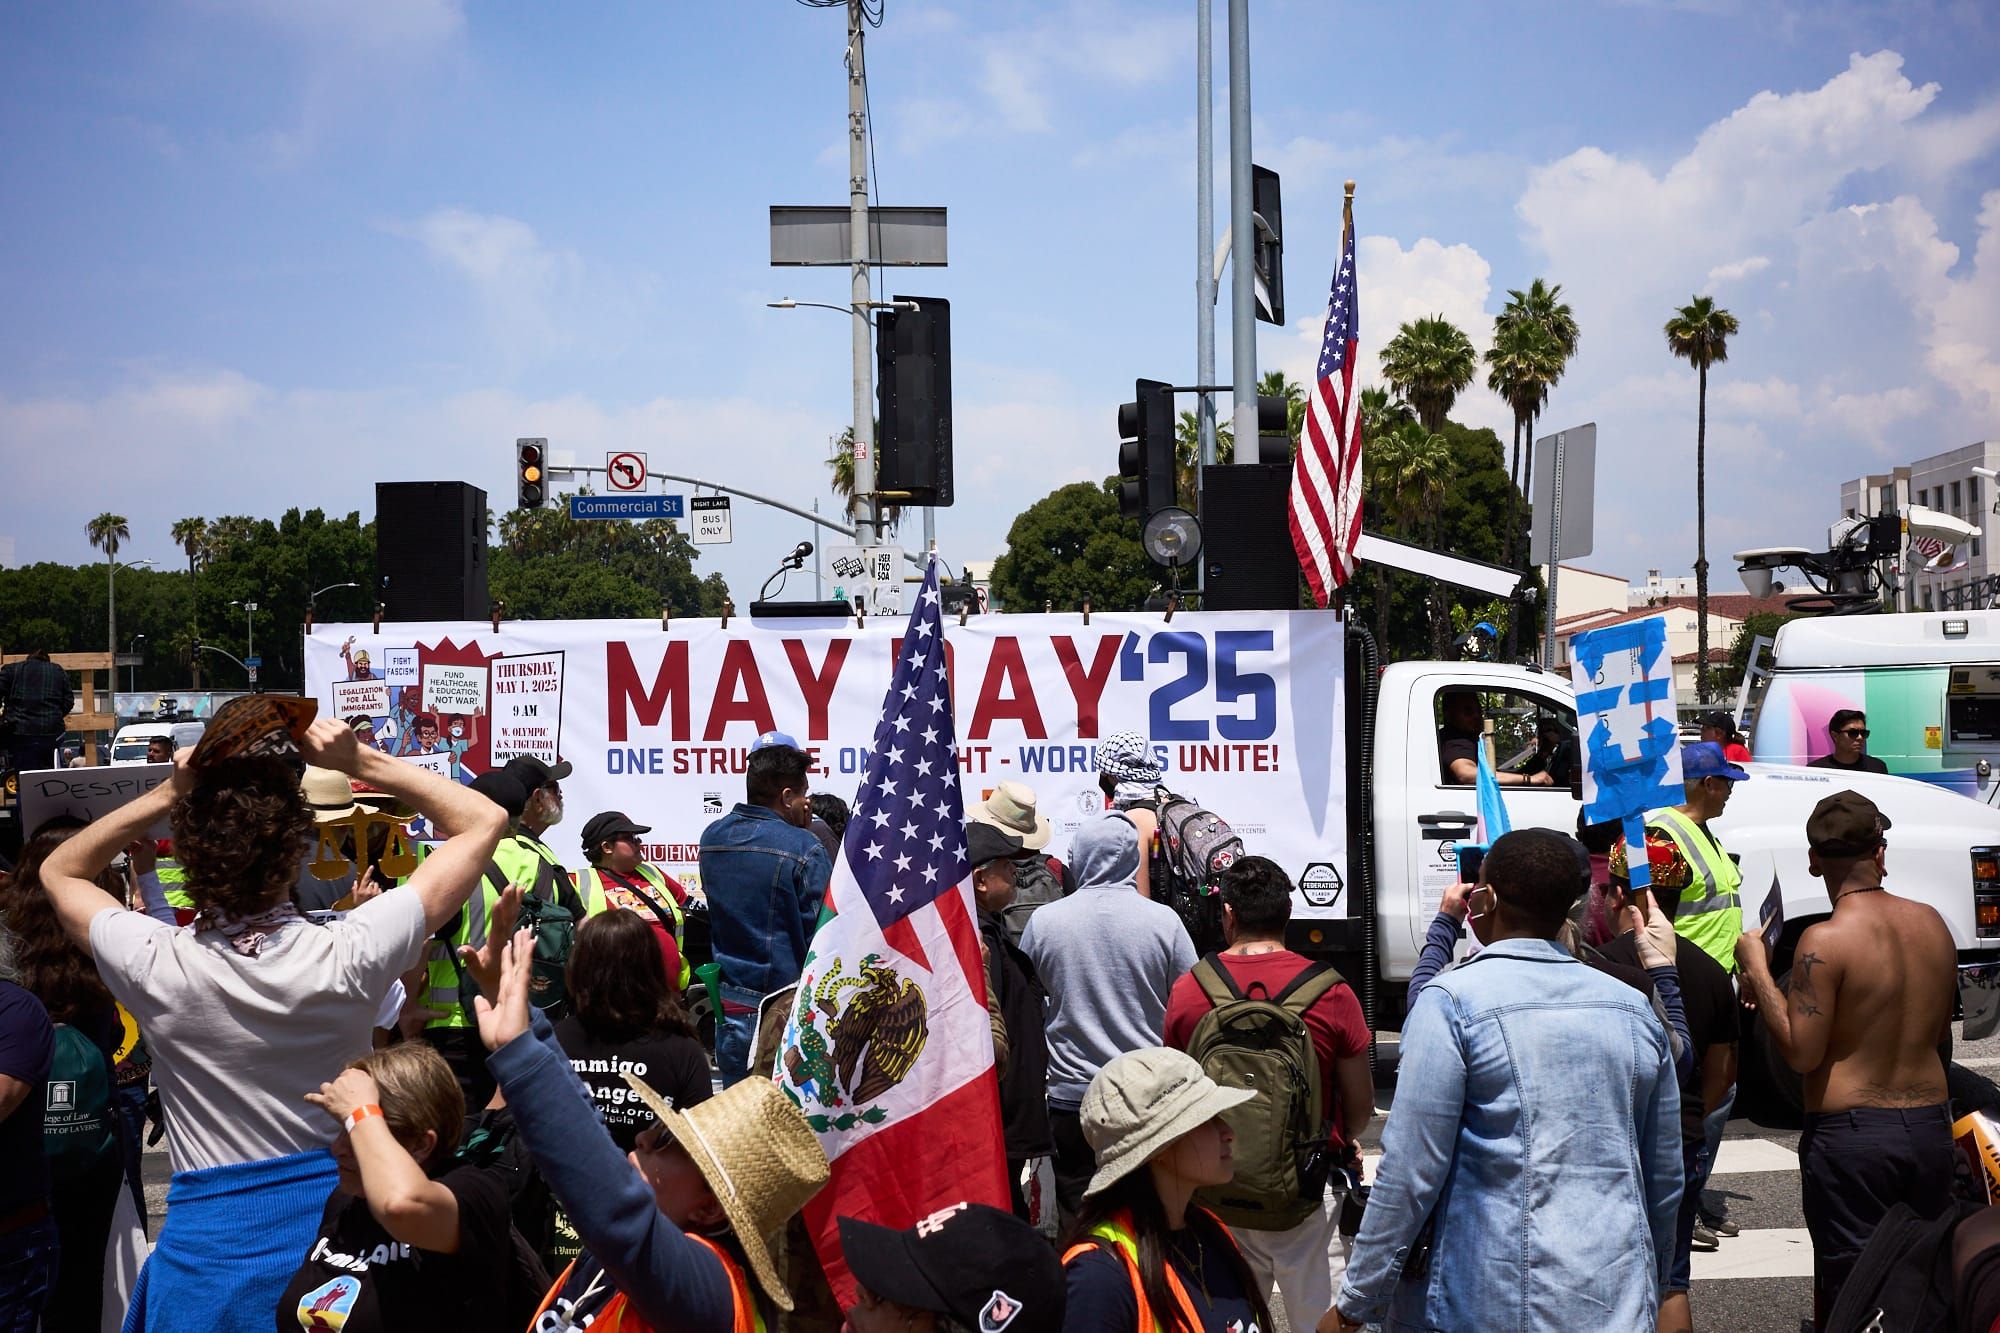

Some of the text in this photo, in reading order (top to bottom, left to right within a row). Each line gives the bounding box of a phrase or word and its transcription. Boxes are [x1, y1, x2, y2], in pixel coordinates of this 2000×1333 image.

[578, 500, 678, 514] Commercial St
[702, 516, 721, 524] BUS
[700, 527, 723, 536] ONLY
[392, 657, 412, 666] FIGHT
[386, 667, 418, 676] FASCISM!
[496, 662, 557, 678] THURSDAY,
[430, 678, 478, 688] HEALTHCARE
[496, 680, 558, 694] MAY 1, 2025
[606, 638, 853, 742] MAY
[891, 634, 1124, 740] AY
[339, 686, 384, 696] LEGALIZATION
[436, 688, 480, 697] EDUCATION,
[362, 694, 377, 702] ALL
[435, 696, 478, 705] NOT WAR!
[341, 704, 384, 712] IMMIGRANTS!
[513, 705, 538, 716] 9 AM
[502, 728, 548, 737] W. OLYMPIC
[496, 740, 553, 750] & S. FIGUEROA
[542, 752, 552, 761] LA
[607, 748, 664, 774] ONE
[673, 747, 830, 778] STRUE,
[1019, 746, 1169, 773] WORS
[1178, 744, 1279, 772] UNITE!
[34, 778, 168, 799] DESPIE
[569, 1055, 648, 1078] mmigo
[44, 1112, 90, 1124] lege of Law
